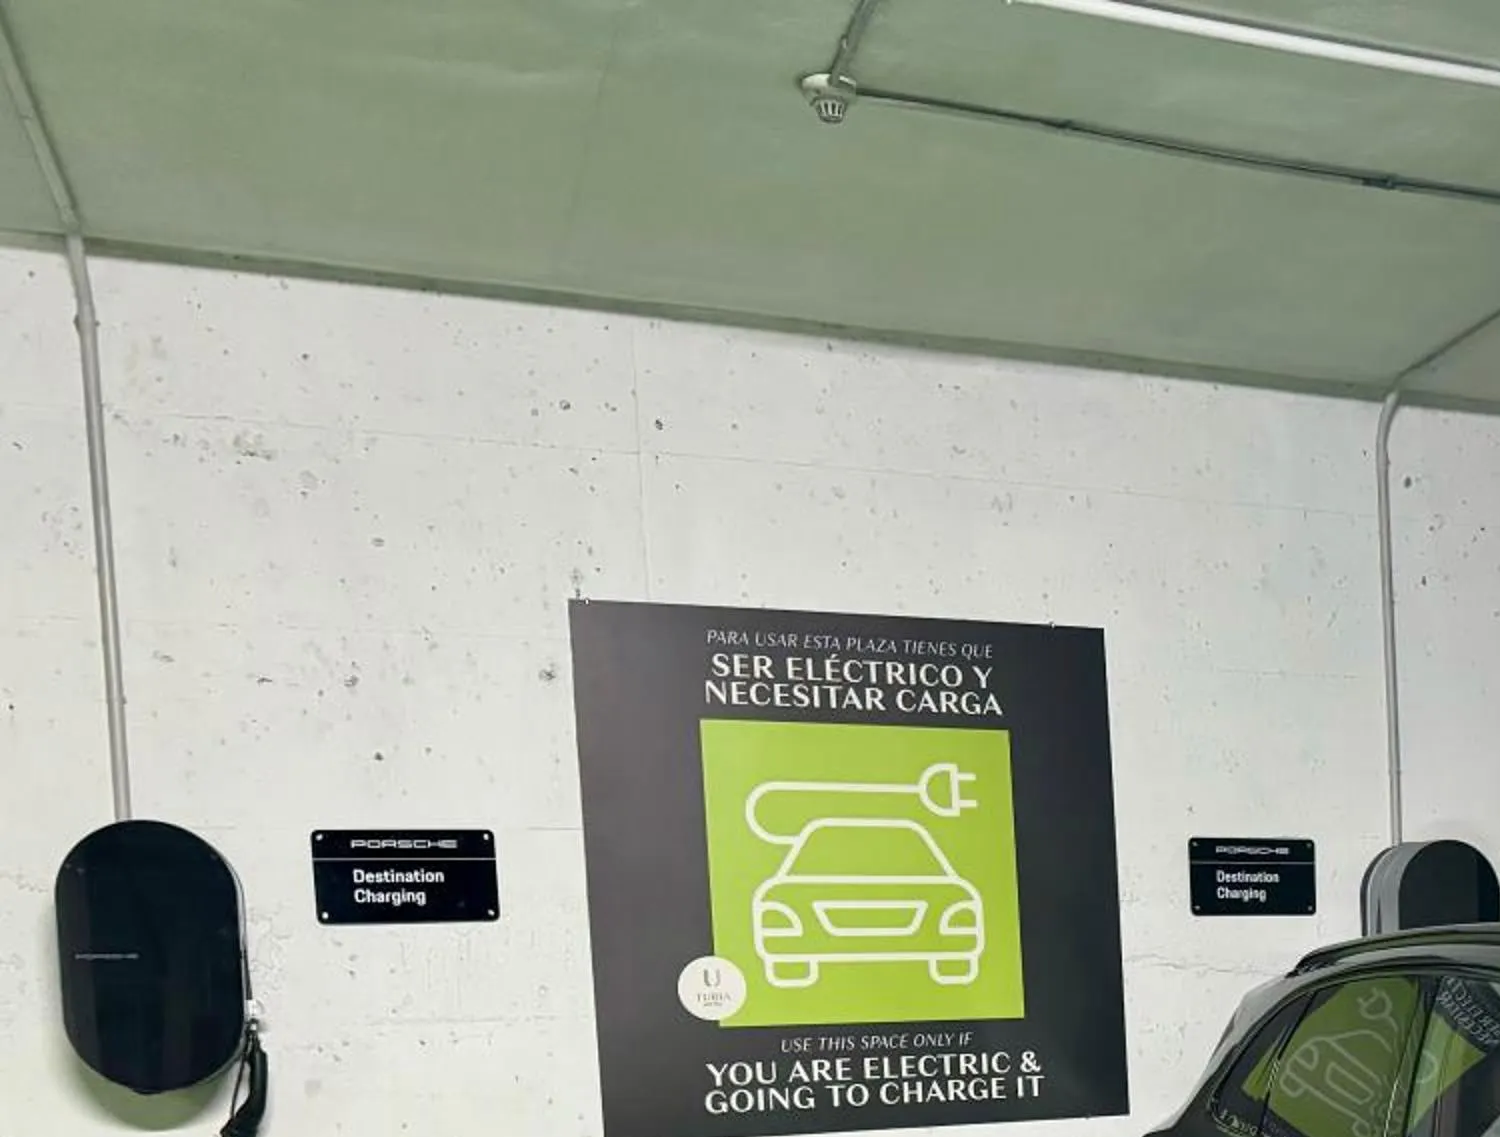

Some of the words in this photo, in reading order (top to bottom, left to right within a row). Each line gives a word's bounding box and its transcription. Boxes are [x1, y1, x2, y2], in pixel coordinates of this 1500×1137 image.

[706, 629, 749, 646] PARA
[755, 632, 798, 649] USAR
[803, 634, 841, 651] ESTA
[846, 636, 897, 654] PLAZA
[903, 639, 957, 658] TIENES
[961, 642, 993, 661] QUE
[711, 653, 774, 679] SER
[787, 651, 963, 688] ELÉCTRICO
[972, 666, 993, 689] Y
[704, 680, 887, 711] NECESITAR
[896, 689, 1003, 716] CARGA
[351, 839, 458, 849] PORSCHE
[352, 868, 445, 883] Destination
[1216, 869, 1280, 883] Destination
[353, 888, 427, 906] Charging
[1216, 886, 1267, 903] Charging
[781, 1036, 813, 1054] USE
[818, 1034, 855, 1052] THIS
[860, 1033, 908, 1050] SPACE
[913, 1032, 954, 1049] ONLY
[959, 1031, 975, 1046] IF
[705, 1061, 778, 1087] YOU
[787, 1058, 852, 1083] ARE
[863, 1051, 1011, 1081] ELECTRIC
[1020, 1050, 1042, 1074] &
[705, 1085, 816, 1115] GOING
[824, 1083, 870, 1108] TO
[879, 1076, 1006, 1106] CHARGE
[1016, 1075, 1045, 1099] IT
